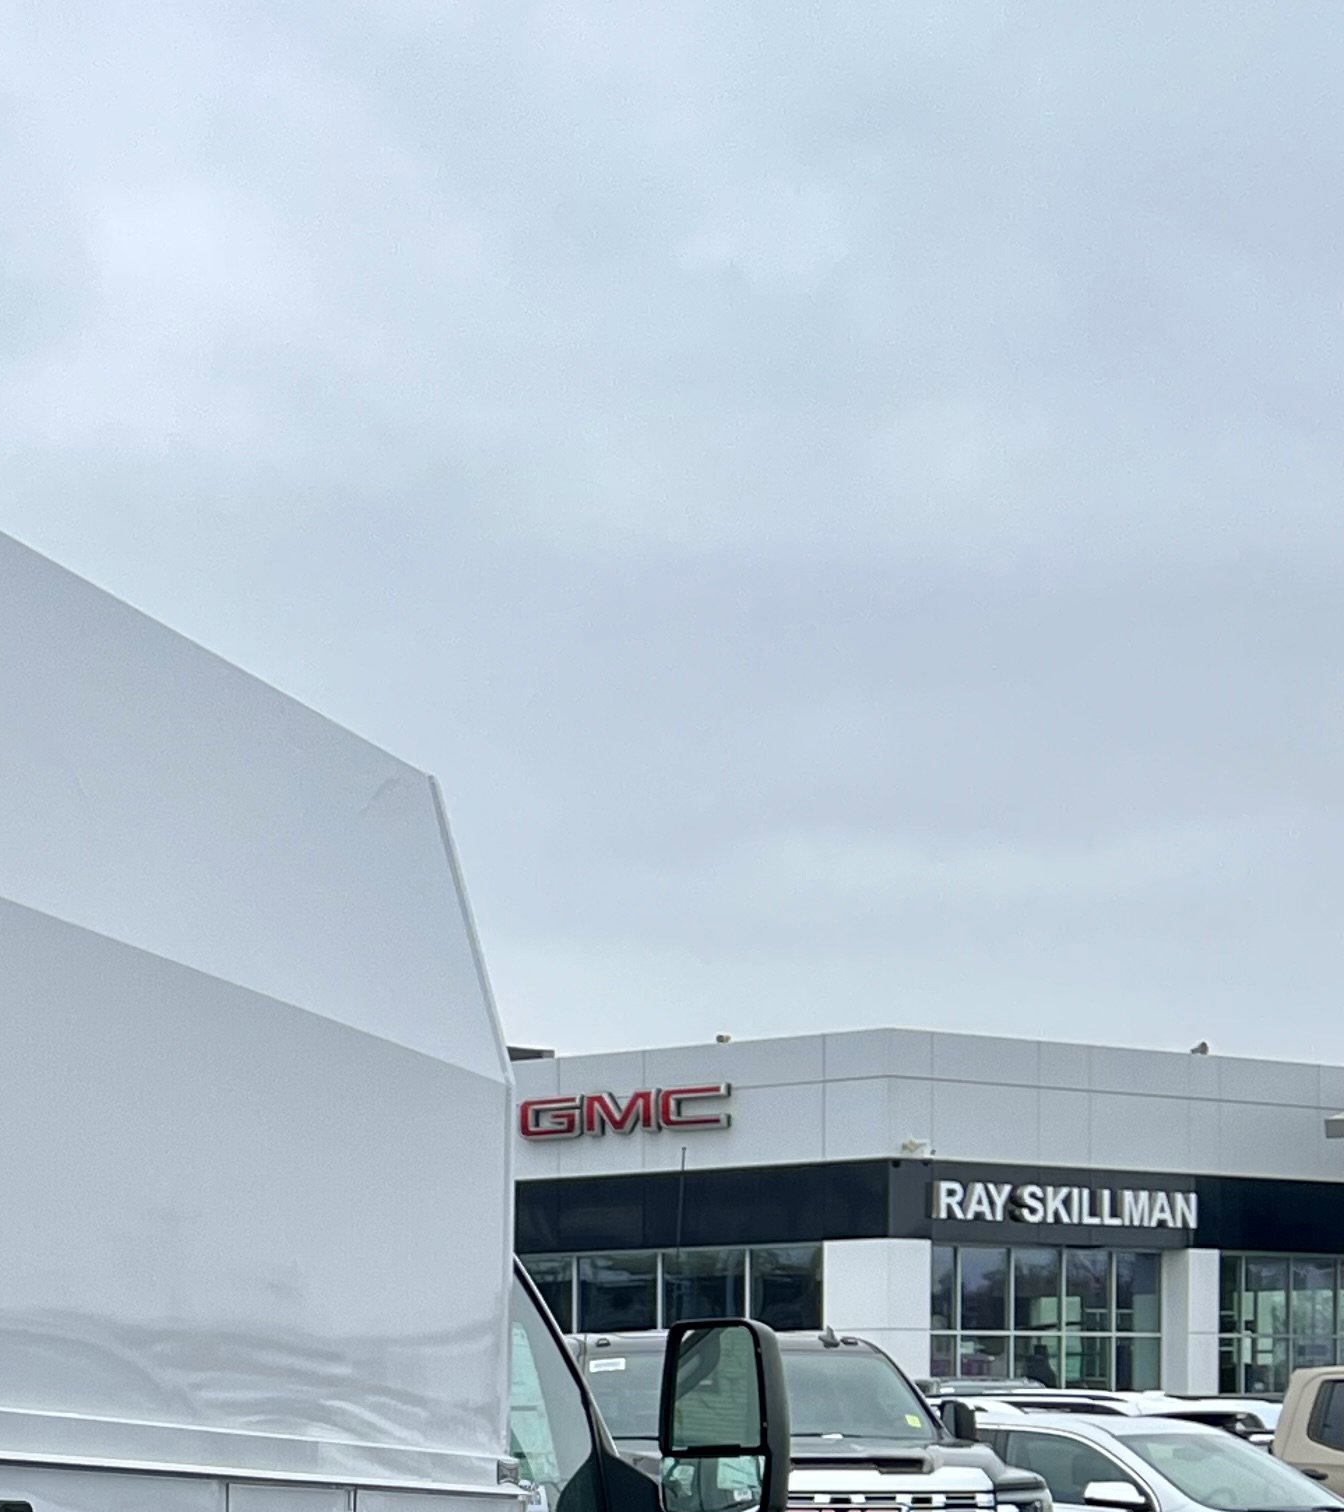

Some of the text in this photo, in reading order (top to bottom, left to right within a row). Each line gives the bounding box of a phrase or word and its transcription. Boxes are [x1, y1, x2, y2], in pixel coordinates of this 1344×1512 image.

[520, 1083, 731, 1140] GMC
[933, 1180, 1198, 1229] RAY SKILLMAN
